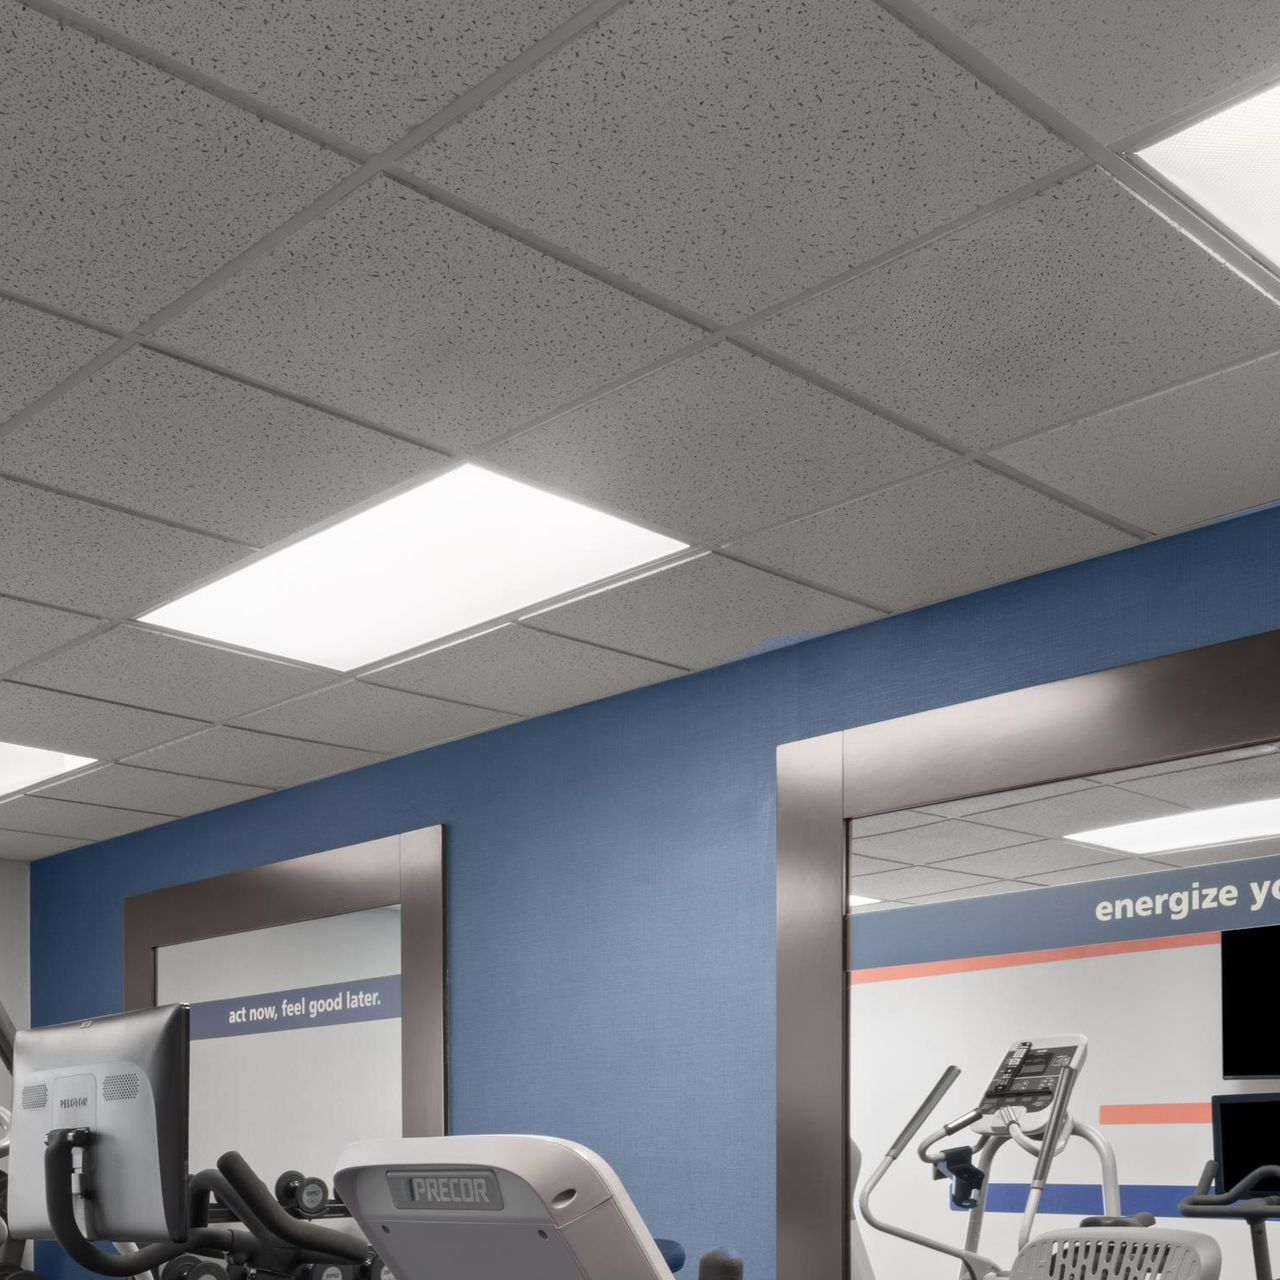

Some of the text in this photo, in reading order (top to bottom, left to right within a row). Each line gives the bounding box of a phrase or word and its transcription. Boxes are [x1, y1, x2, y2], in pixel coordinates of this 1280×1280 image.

[1095, 881, 1238, 921] energize
[228, 990, 381, 1024] act now, feel good later.
[412, 1177, 490, 1203] PRECOR
